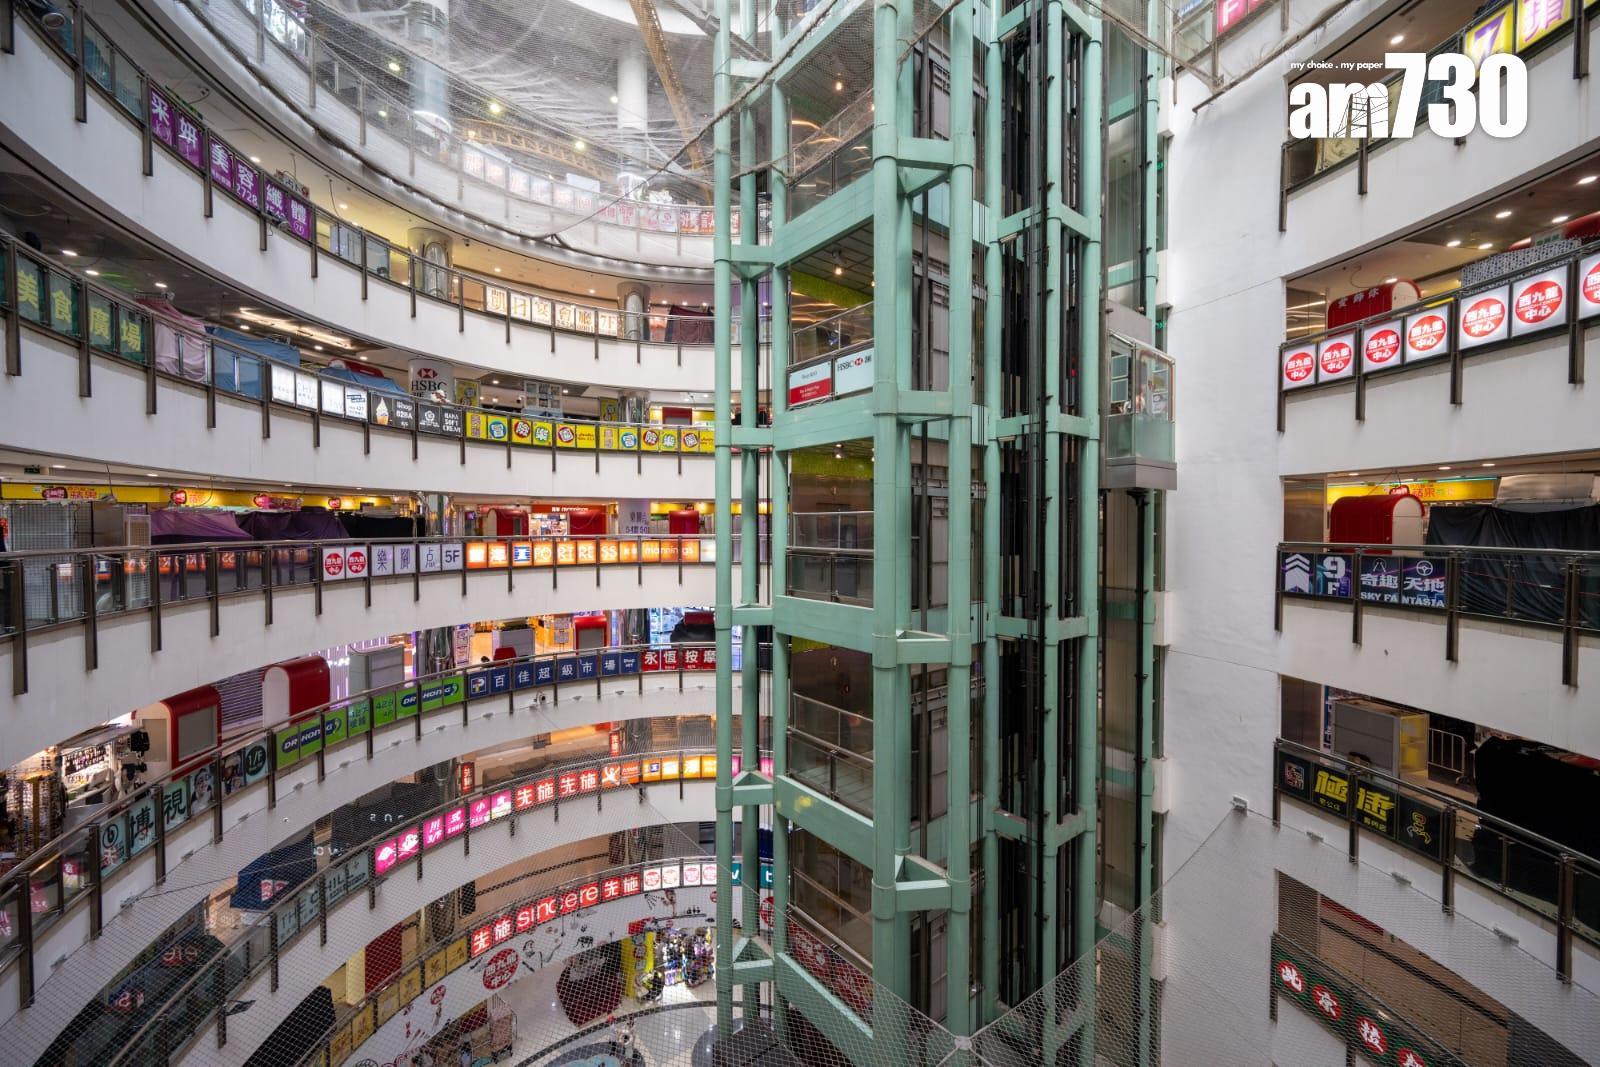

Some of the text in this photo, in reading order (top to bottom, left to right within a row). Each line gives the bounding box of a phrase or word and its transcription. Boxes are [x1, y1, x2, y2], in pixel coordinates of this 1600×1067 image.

[1519, 288, 1559, 308] 西九龍
[1467, 304, 1502, 323] 西九龍
[1525, 305, 1552, 320] 中心
[1411, 319, 1444, 338] 西九龍
[1471, 320, 1496, 334] 中心
[1415, 336, 1438, 349] 中心
[411, 380, 448, 392] HSBC
[445, 550, 460, 563] 5F
[1360, 573, 1445, 593] 奇趣天地
[1360, 592, 1445, 608] SKY FANTASIA
[645, 650, 717, 664] 永恆按摩
[495, 659, 616, 687] 百佳超級市場
[516, 773, 598, 807] 先施 先施
[473, 920, 512, 954] 先施
[517, 886, 598, 927] sincere
[604, 877, 639, 897] 先施
